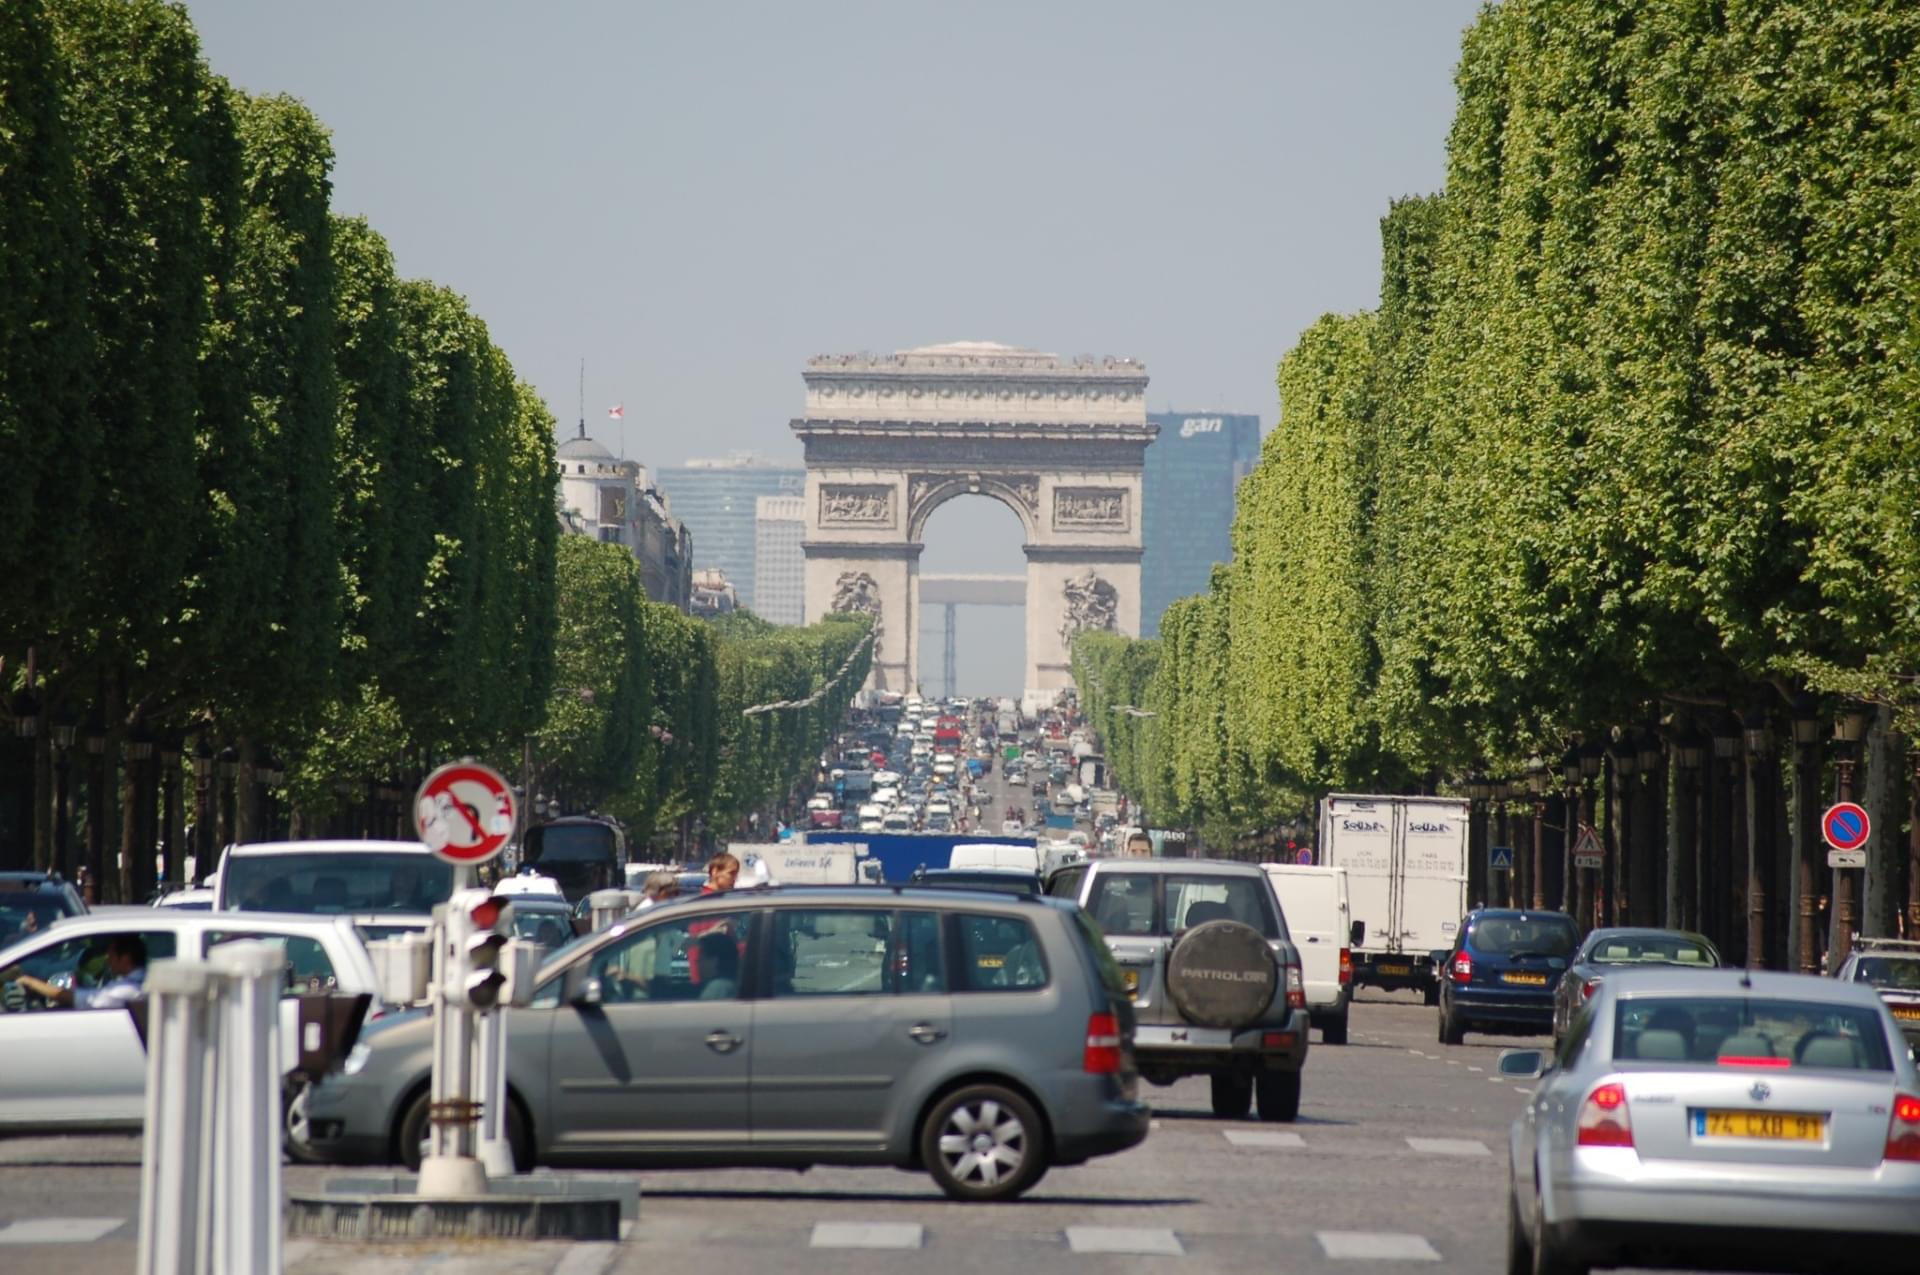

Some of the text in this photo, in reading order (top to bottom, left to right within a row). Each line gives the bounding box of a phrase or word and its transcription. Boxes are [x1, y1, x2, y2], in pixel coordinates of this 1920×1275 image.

[1180, 418, 1222, 438] gan
[1708, 1112, 1733, 1135] 74
[1796, 1116, 1818, 1139] 91
